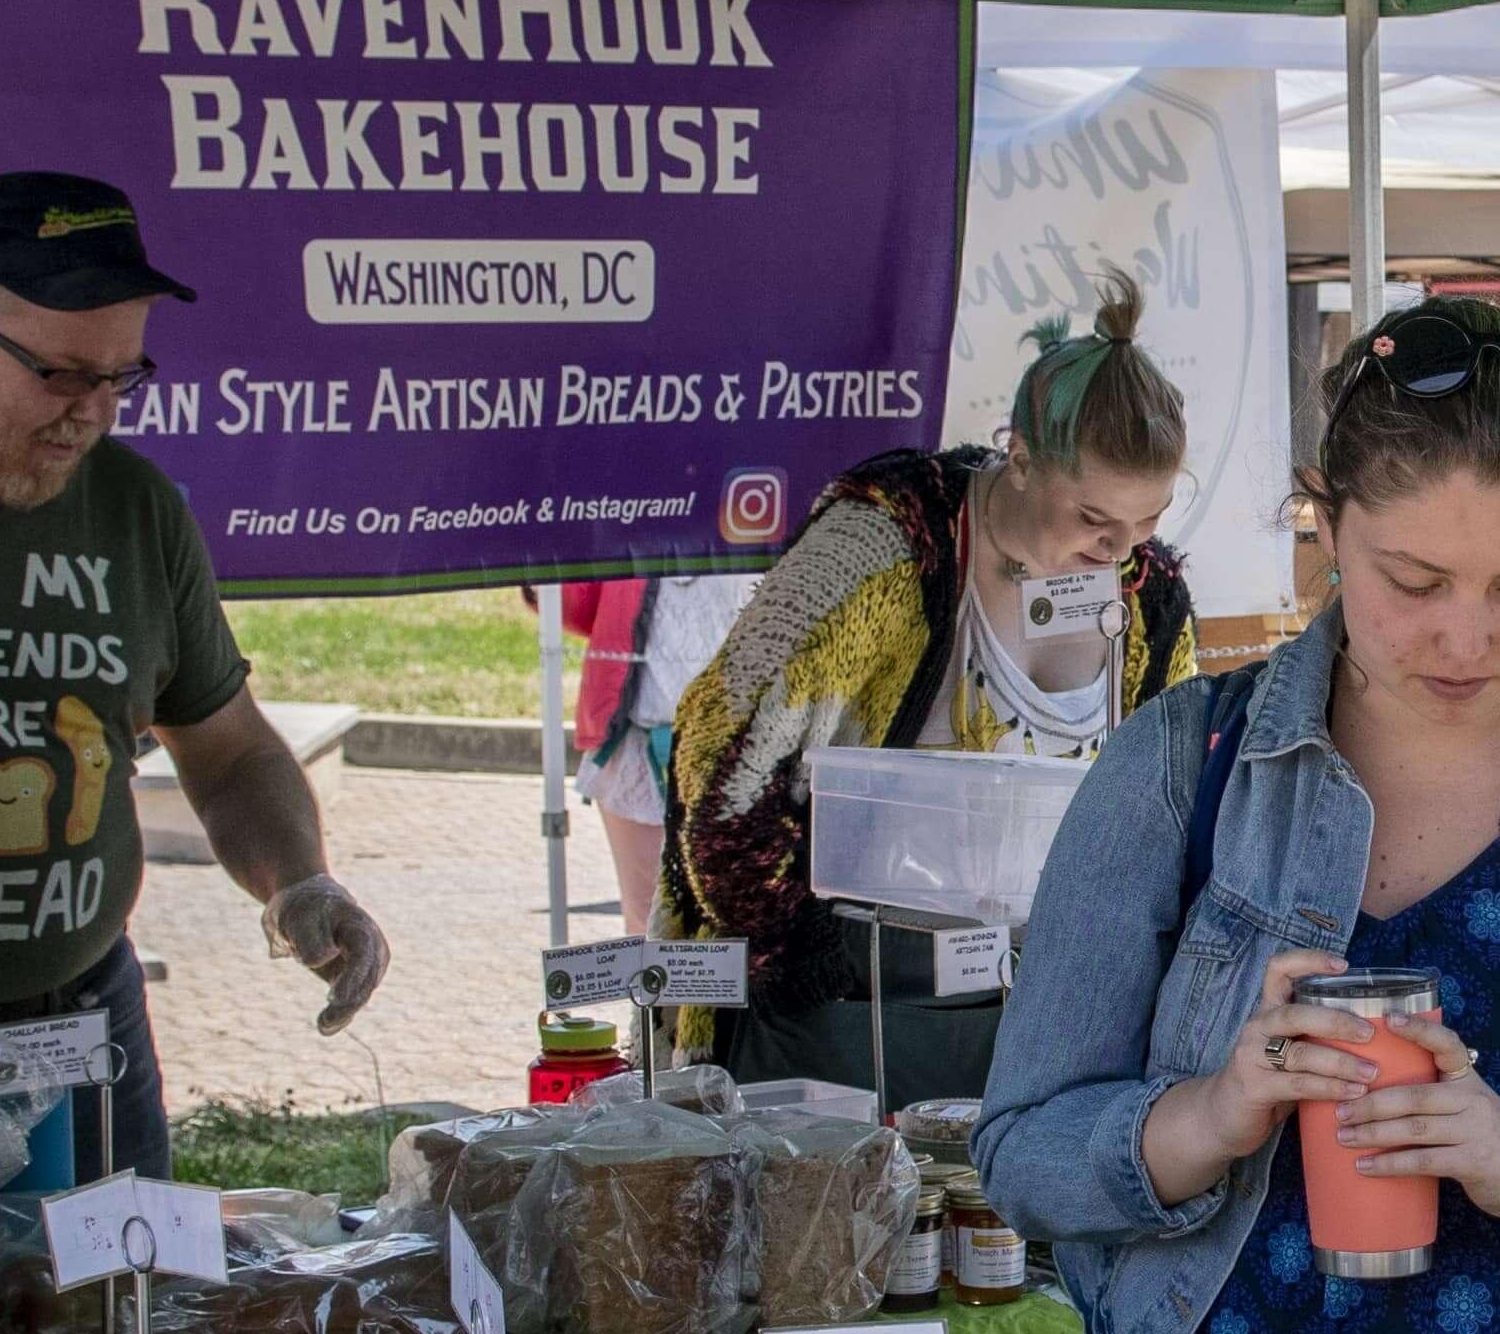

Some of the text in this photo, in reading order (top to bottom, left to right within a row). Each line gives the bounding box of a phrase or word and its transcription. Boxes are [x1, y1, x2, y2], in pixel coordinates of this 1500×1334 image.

[160, 73, 761, 194] BAKEHOUSE
[323, 249, 636, 310] WASHINGTON, DC
[215, 367, 352, 436] STYLE
[367, 367, 545, 432] ARTISAN
[556, 364, 702, 426] BREADS
[714, 373, 747, 423] &
[757, 361, 924, 420] PASTRIES
[226, 491, 697, 536] Find Us On Facebook & Instagram!
[21, 551, 112, 614] MY
